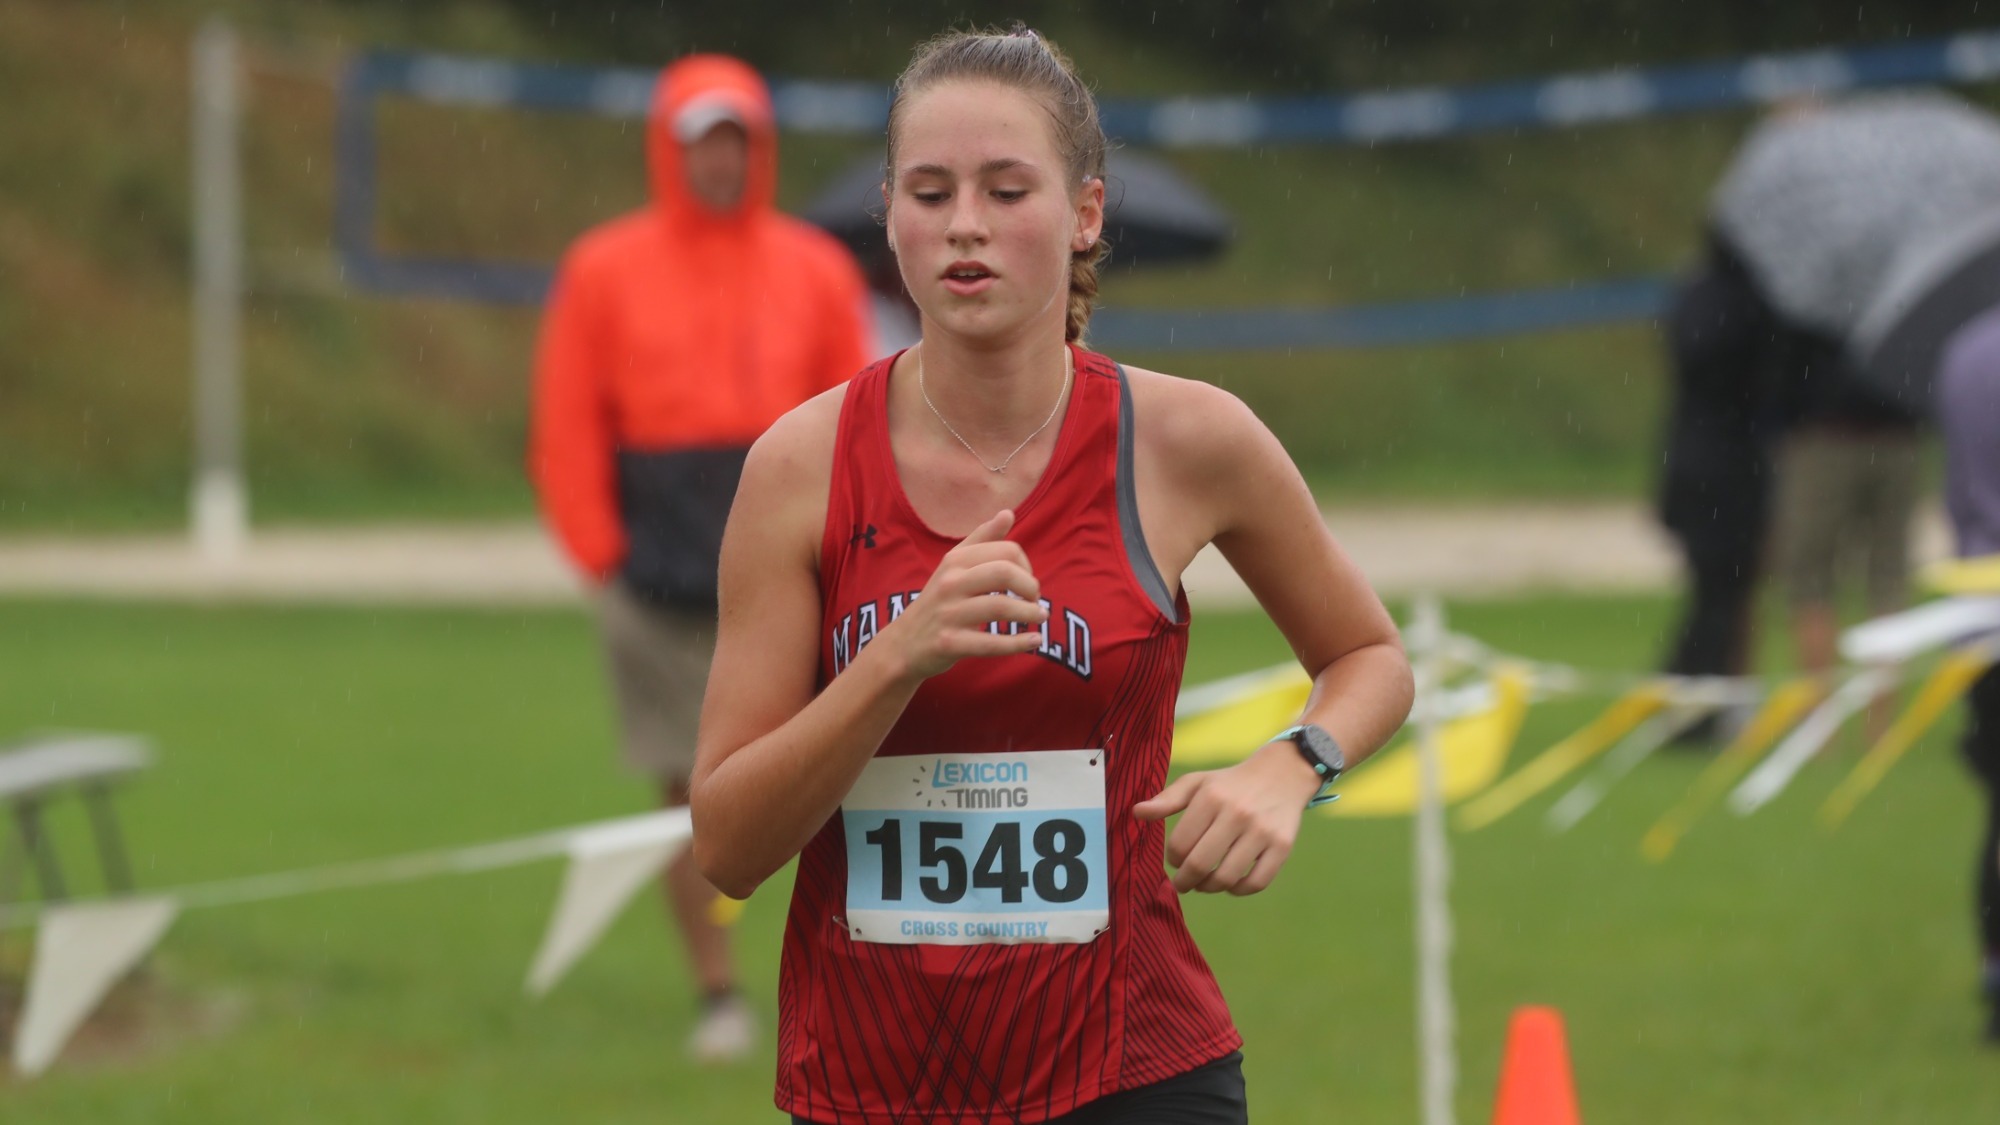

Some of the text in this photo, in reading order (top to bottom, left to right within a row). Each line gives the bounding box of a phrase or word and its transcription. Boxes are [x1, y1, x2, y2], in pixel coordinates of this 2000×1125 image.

[946, 787, 1028, 808] TIMING
[866, 818, 1089, 904] 1548
[901, 920, 1048, 937] CROSS COUNTRY
